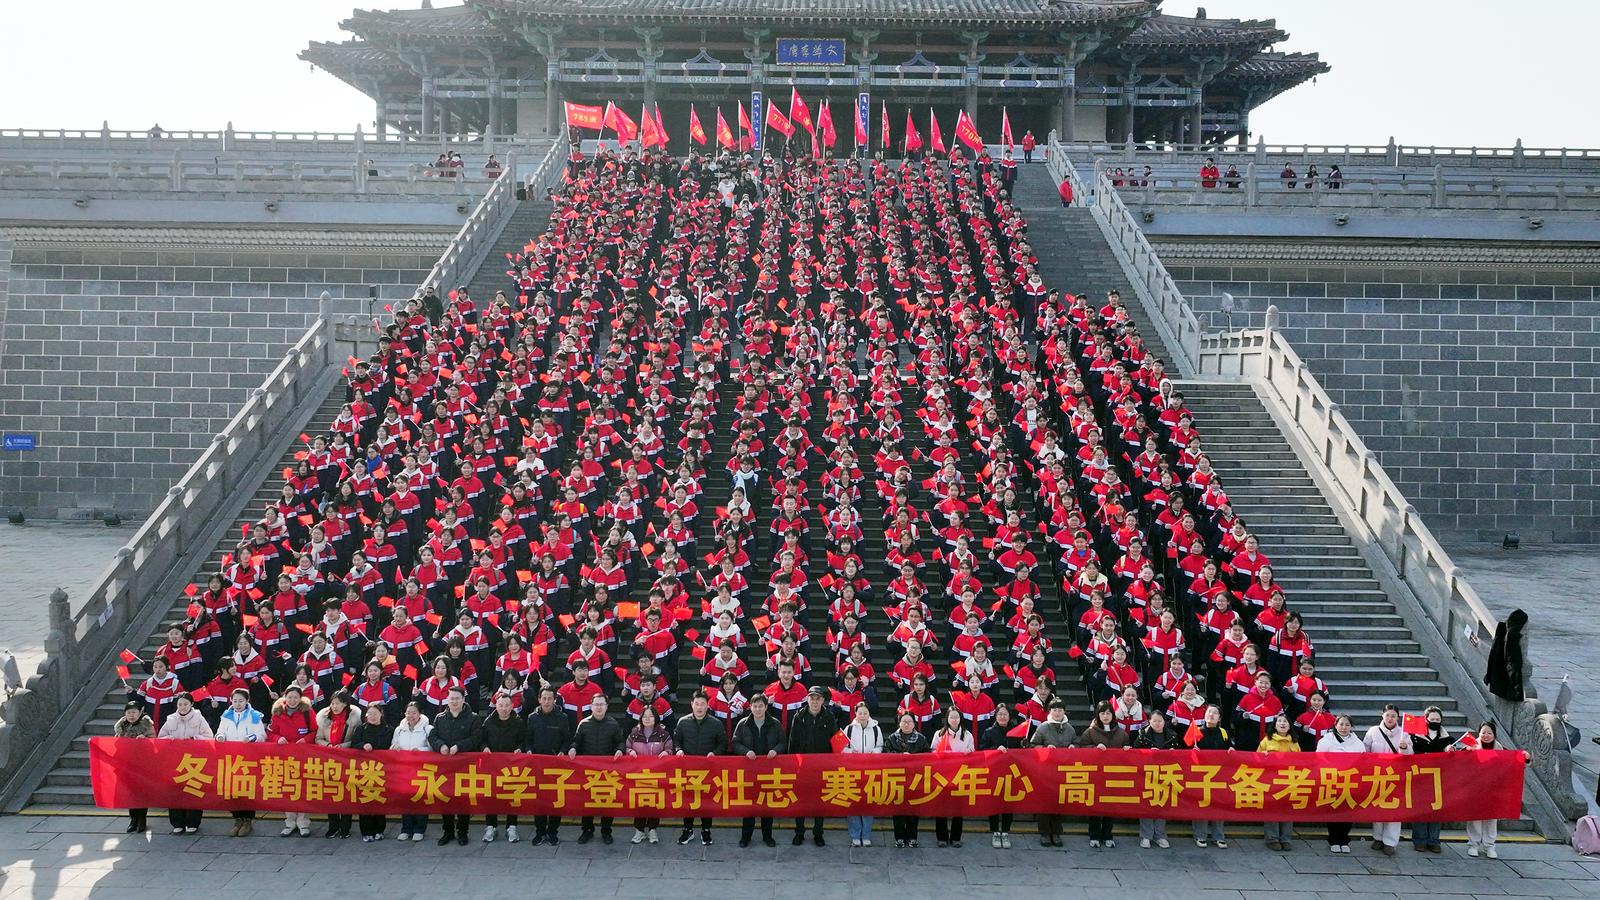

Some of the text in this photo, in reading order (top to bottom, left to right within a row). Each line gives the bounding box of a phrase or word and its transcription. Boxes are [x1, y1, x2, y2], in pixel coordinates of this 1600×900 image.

[172, 753, 1443, 810] 冬临鹳鹊楼 永中学子登高抒壮志 寒砺少年心 高三骄子备考跃龙门
